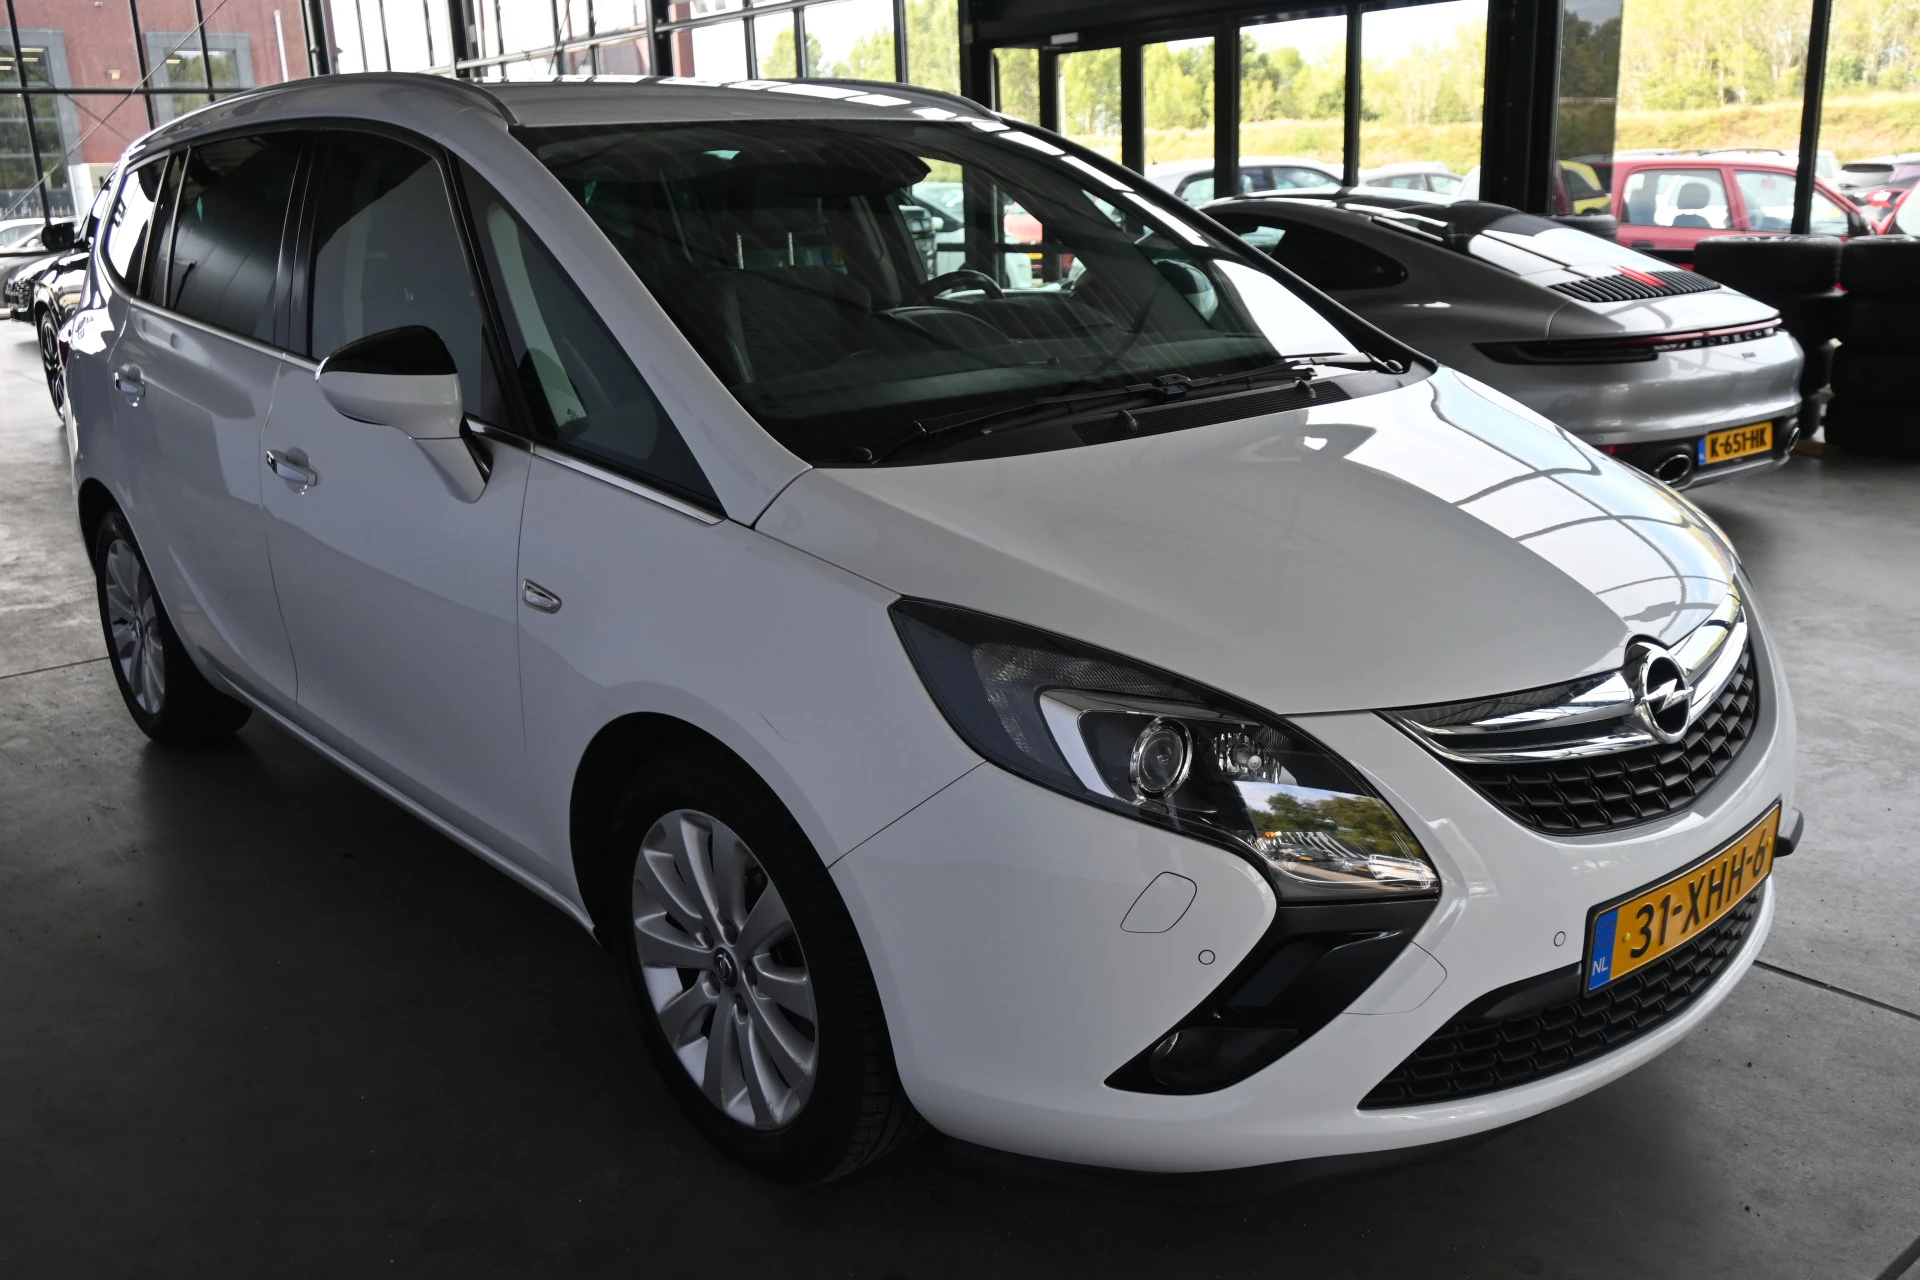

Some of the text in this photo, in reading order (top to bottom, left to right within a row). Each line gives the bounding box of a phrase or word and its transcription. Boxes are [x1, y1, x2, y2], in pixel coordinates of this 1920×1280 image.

[1710, 427, 1767, 459] K-651-HK
[1630, 826, 1767, 958] 31-XHH-6
[1592, 956, 1608, 976] NL
